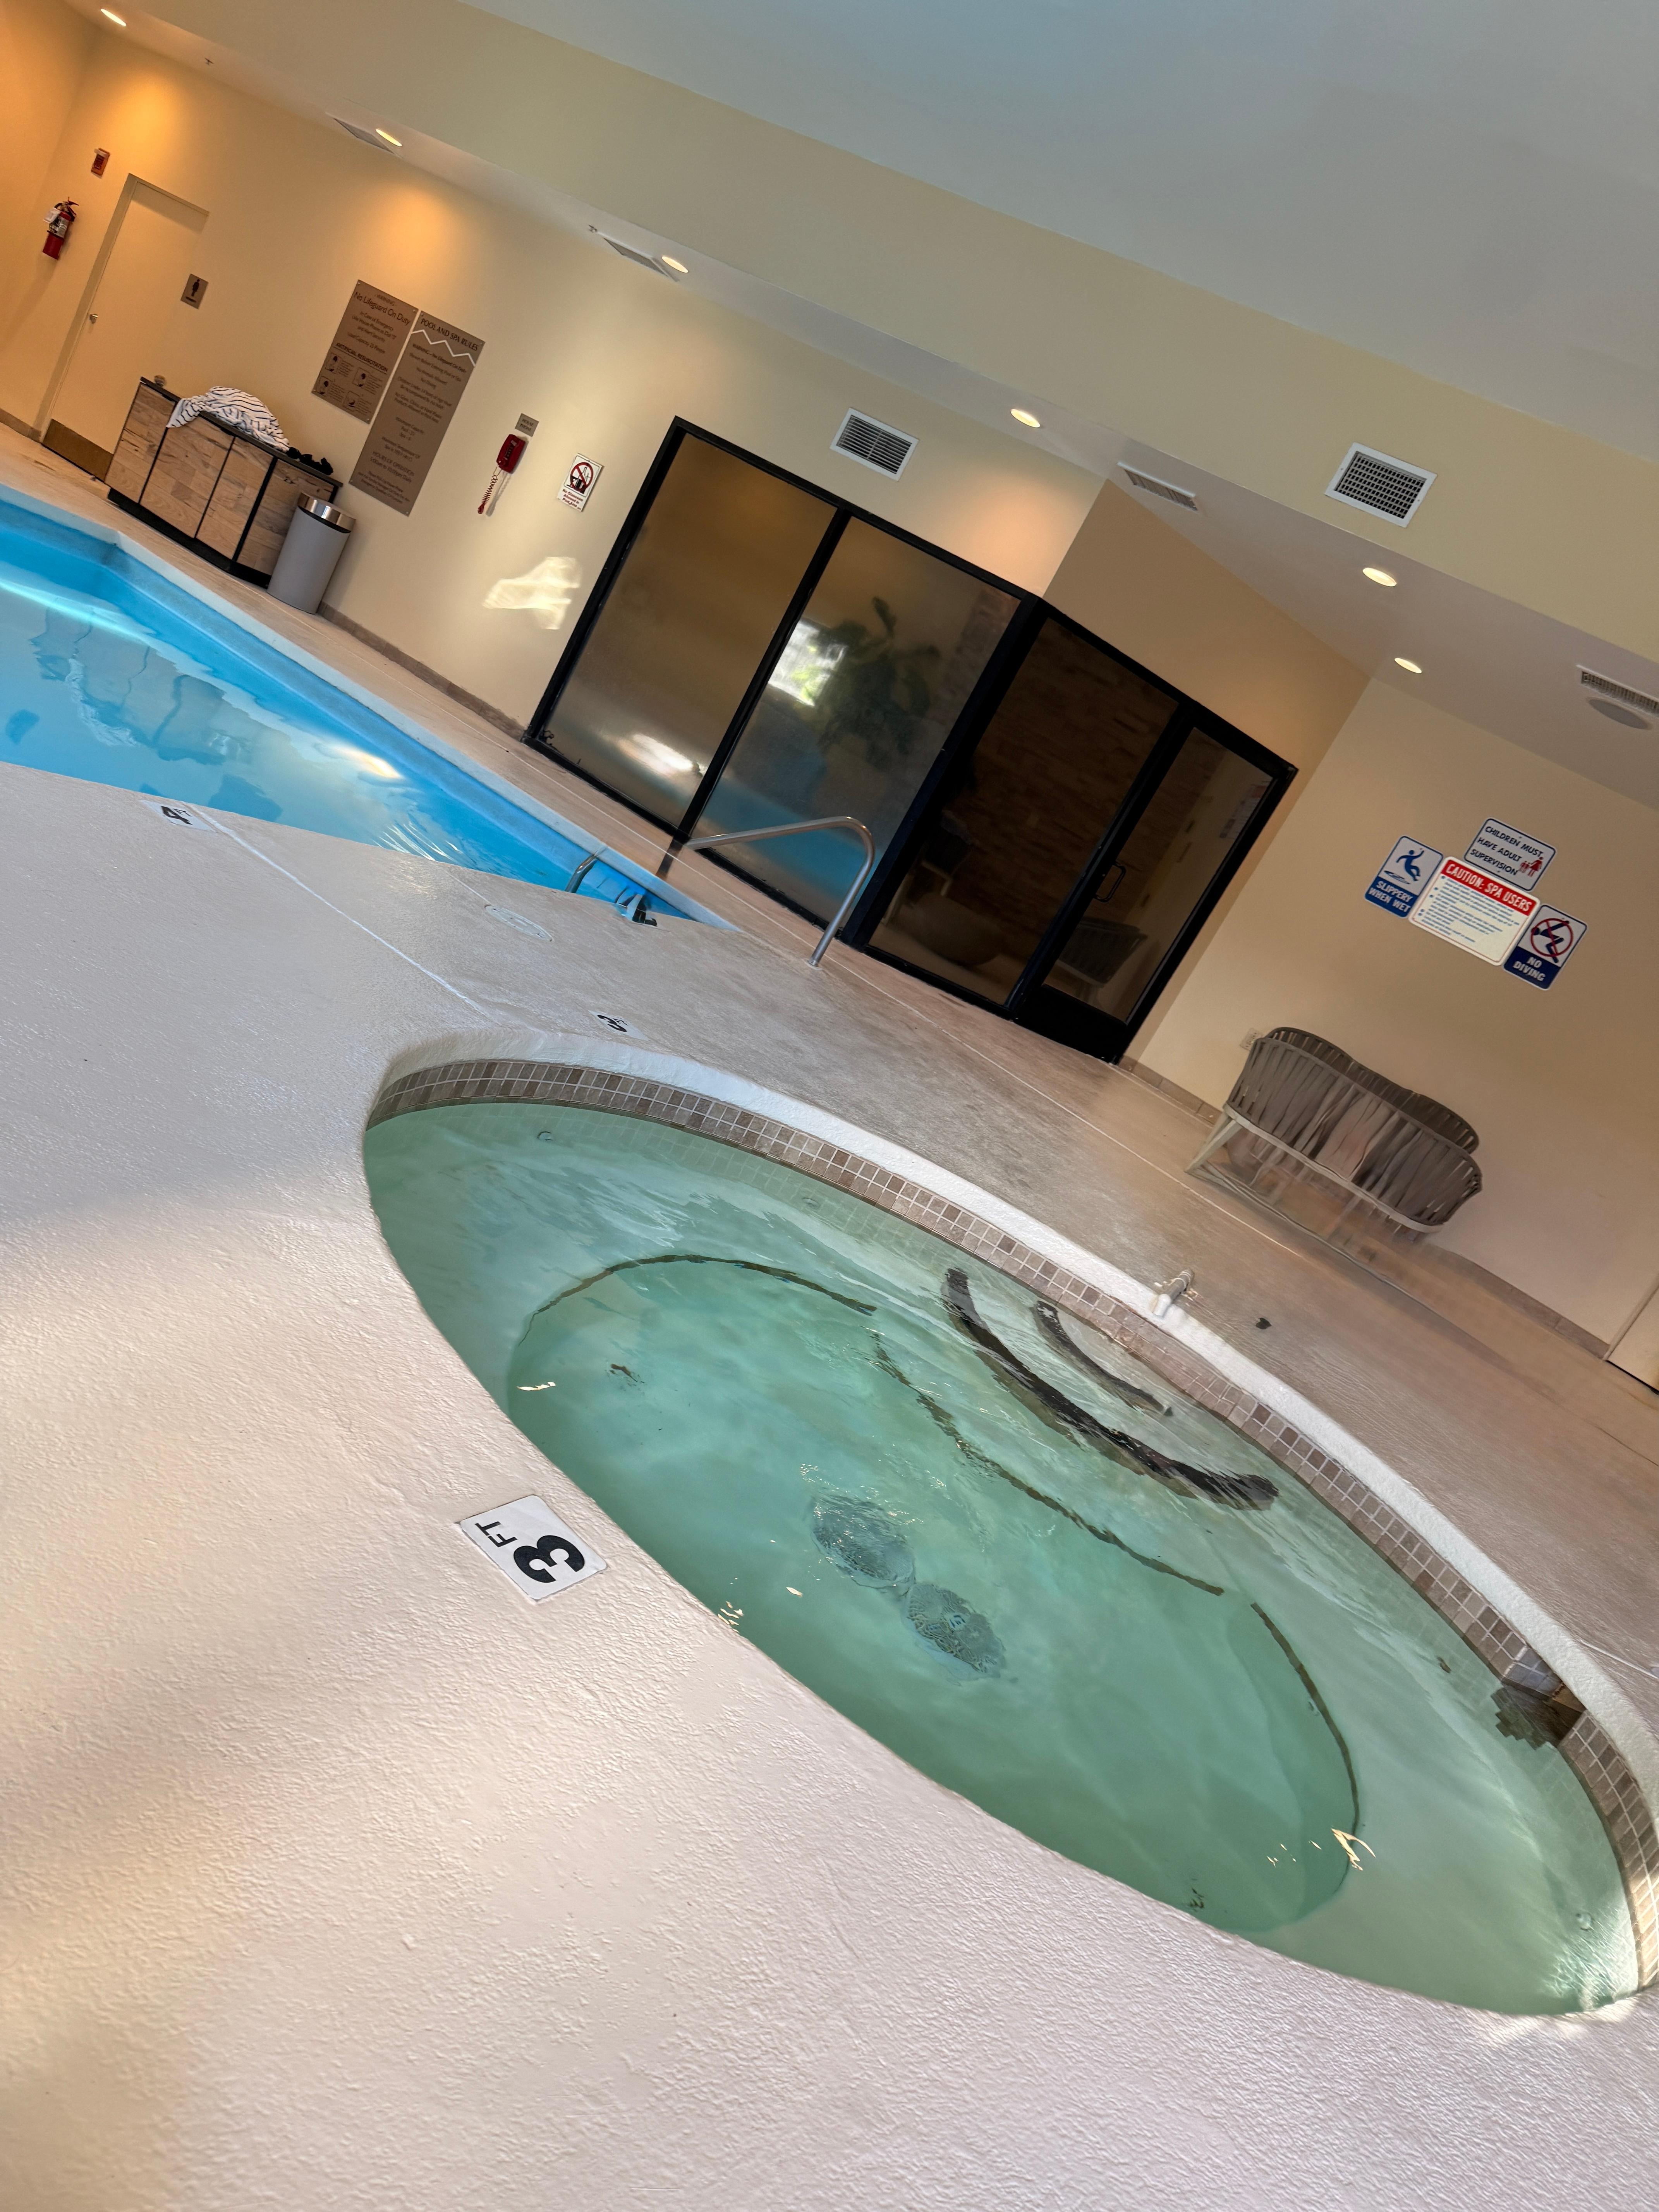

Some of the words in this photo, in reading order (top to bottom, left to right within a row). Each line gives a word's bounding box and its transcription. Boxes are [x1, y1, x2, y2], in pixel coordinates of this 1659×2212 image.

[354, 291, 363, 301] No
[363, 296, 387, 314] Lifeguard
[387, 308, 397, 317] On
[396, 313, 411, 326] Duty
[421, 318, 436, 330] POOL
[436, 326, 450, 337] AND
[450, 332, 460, 342] SPA
[461, 338, 478, 350] RULES
[161, 806, 193, 825] 4
[173, 809, 192, 817] FT
[1477, 837, 1497, 850] HAVE
[1498, 847, 1522, 862] ADULT
[1485, 826, 1520, 846] CHILDREN
[1521, 843, 1543, 857] MUST
[1470, 849, 1518, 875] SUPERVISION
[1376, 881, 1412, 902] SLIPPERY
[1446, 863, 1486, 889] CAUTION:
[1485, 883, 1504, 897] SPA
[1503, 891, 1532, 911] USERS
[1368, 888, 1392, 903] WHEN
[1392, 899, 1410, 912] WET
[1512, 960, 1546, 982] DIVING
[1527, 956, 1542, 969] NO
[597, 1015, 627, 1032] 3
[475, 1521, 517, 1547] FT
[514, 1535, 585, 1583] 3
